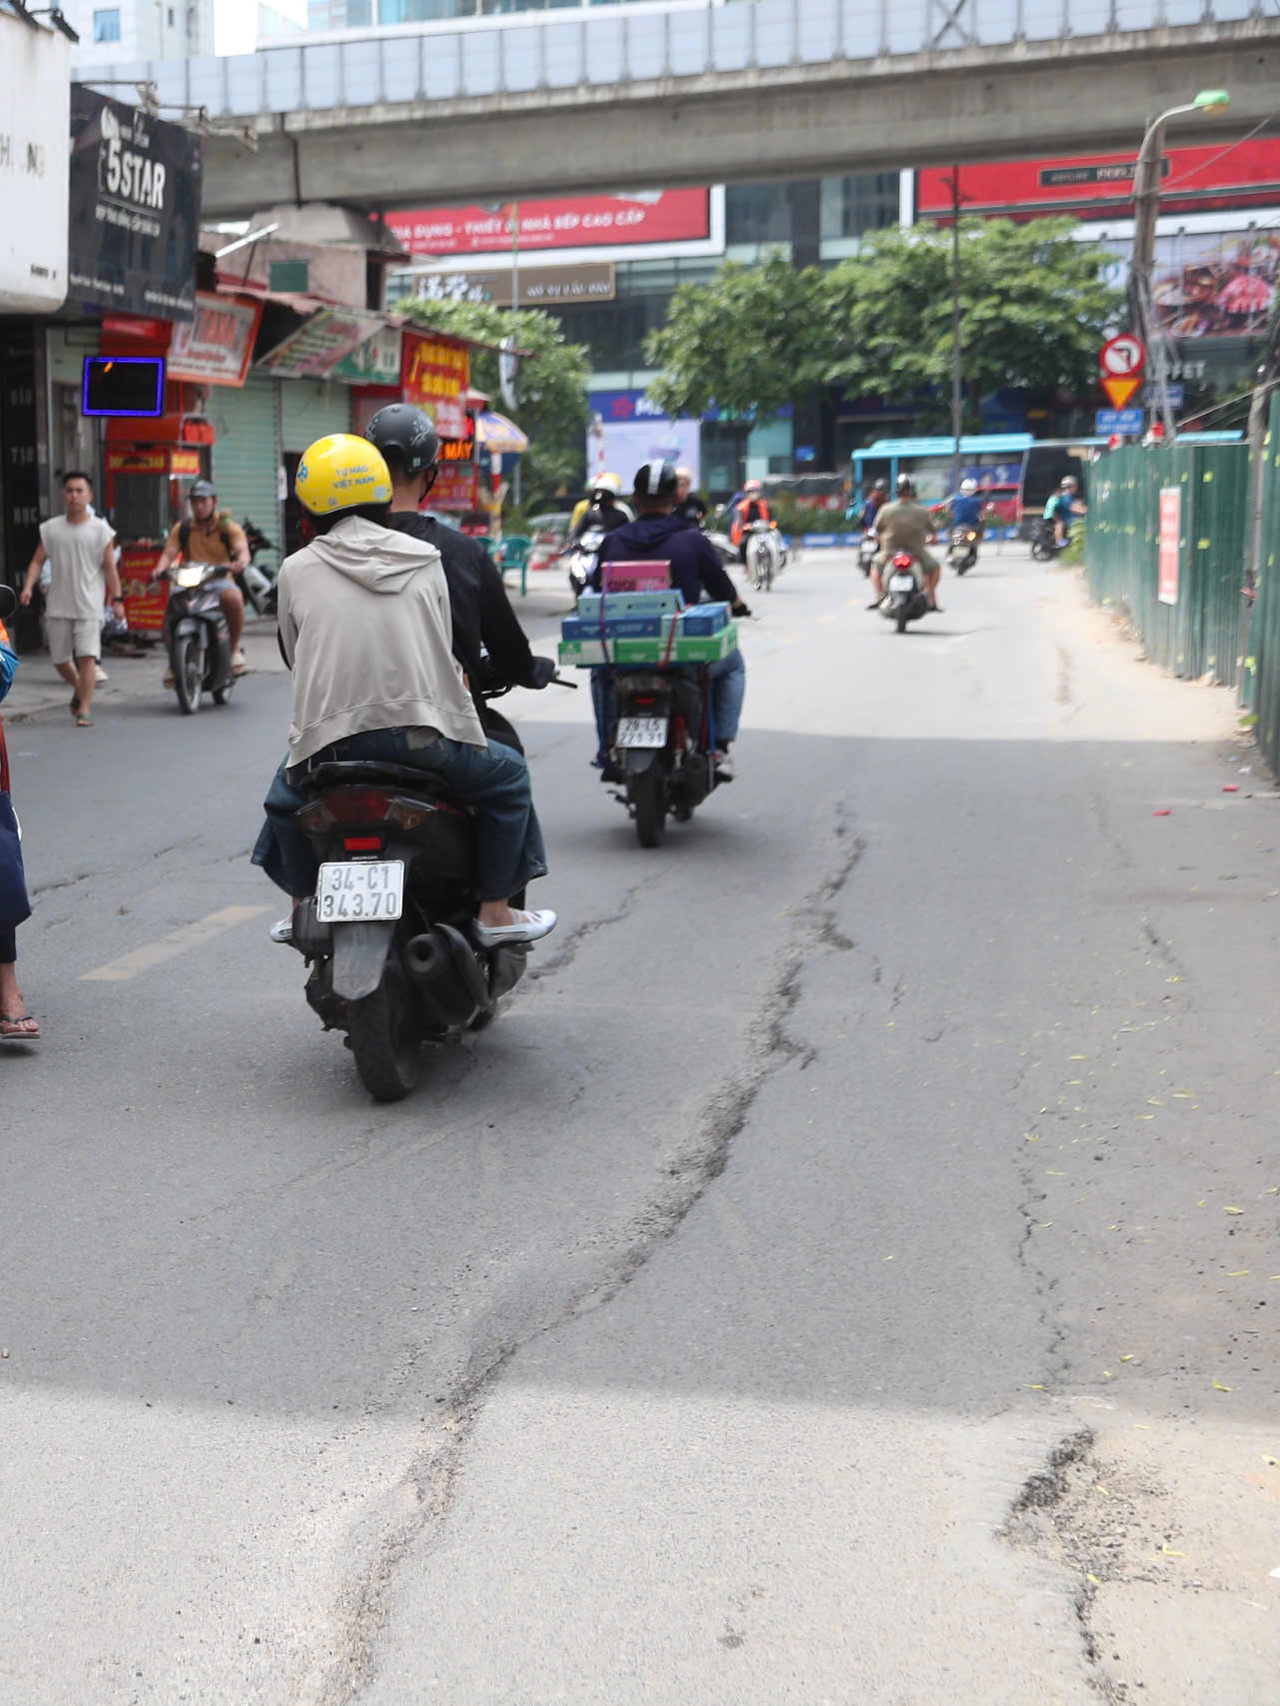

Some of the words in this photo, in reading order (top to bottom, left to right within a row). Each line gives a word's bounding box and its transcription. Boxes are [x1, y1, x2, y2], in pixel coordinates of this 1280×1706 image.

[582, 212, 613, 228] CAO
[354, 475, 375, 487] NAM
[331, 865, 391, 891] 34-C1
[323, 892, 397, 918] 343.70
